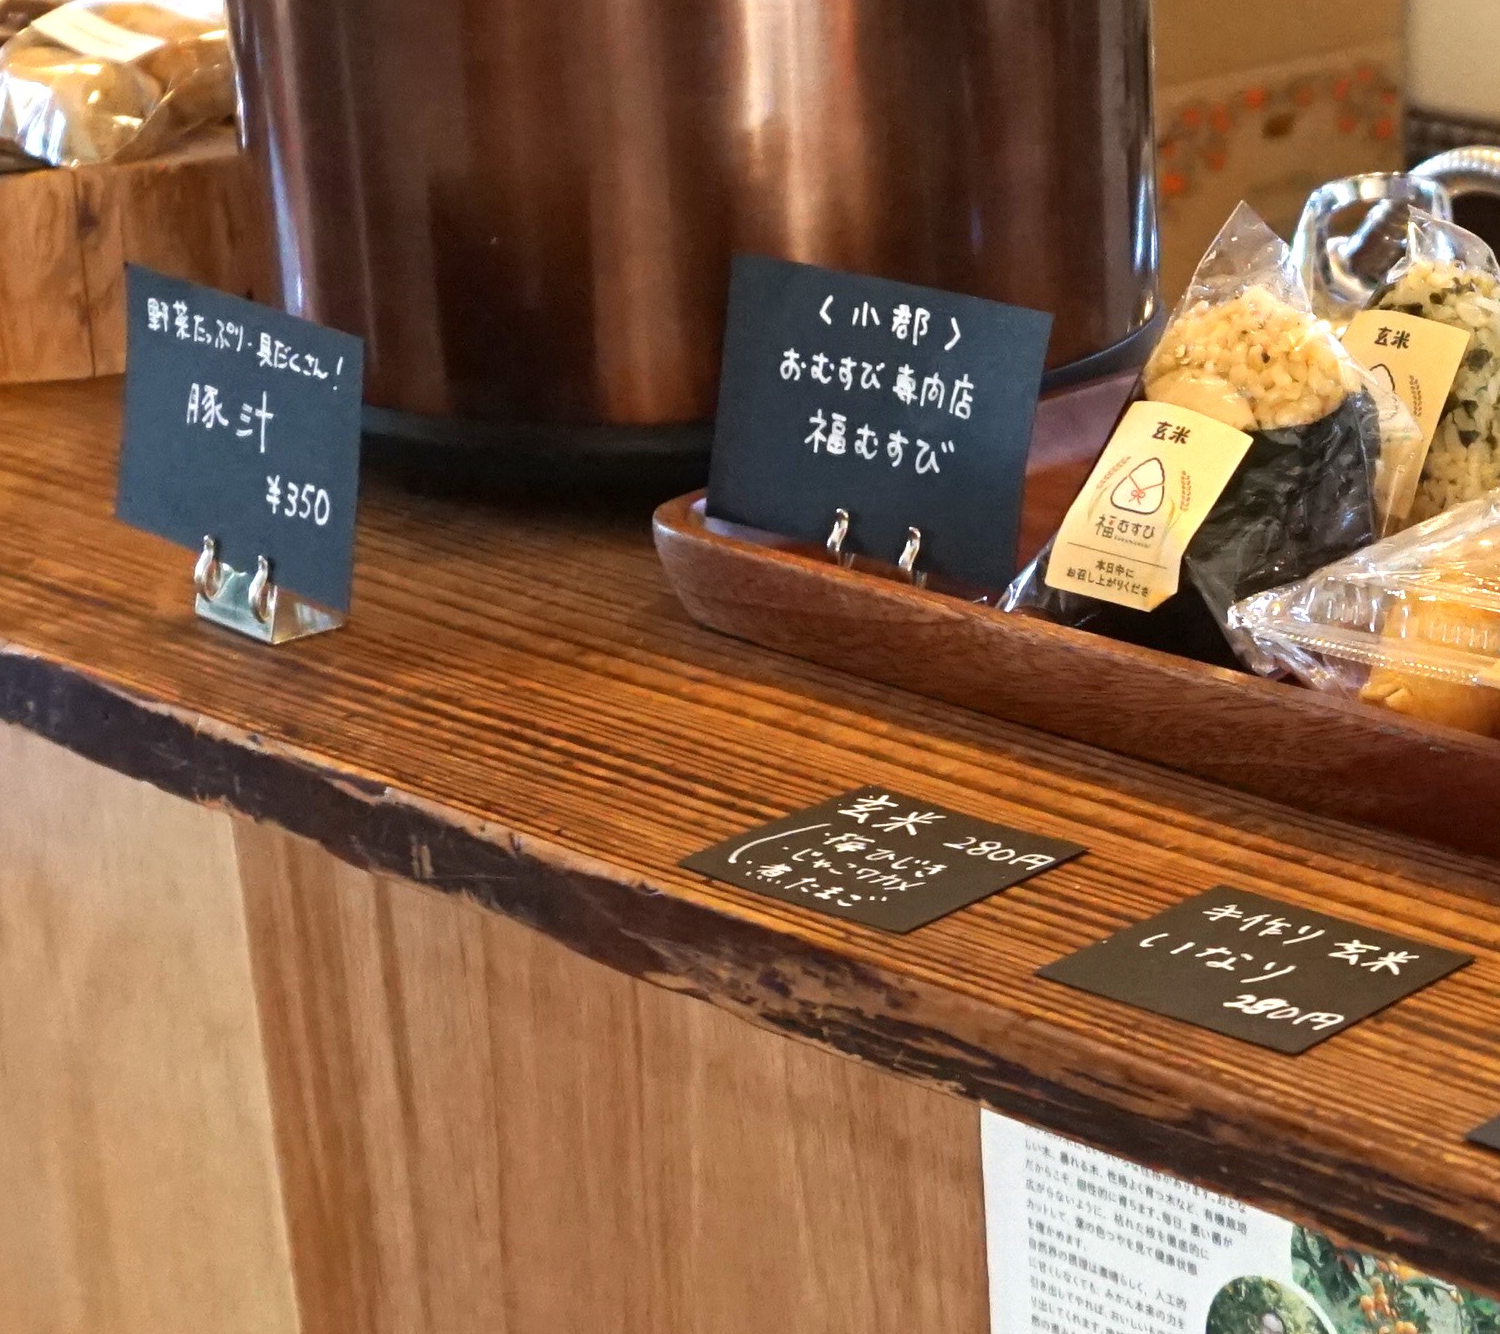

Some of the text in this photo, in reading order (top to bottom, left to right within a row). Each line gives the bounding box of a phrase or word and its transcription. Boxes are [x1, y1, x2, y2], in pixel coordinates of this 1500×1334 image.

[1374, 326, 1411, 349] 玄米
[186, 382, 274, 454] 豚汁
[804, 409, 955, 474] 福むすび
[1151, 420, 1192, 445] 玄米
[265, 475, 331, 526] ¥350
[1066, 567, 1150, 597] お召し上がりくださ
[838, 794, 1056, 871] 玄米 280円
[1138, 932, 1298, 984] いなり
[1223, 993, 1345, 1033] 280円
